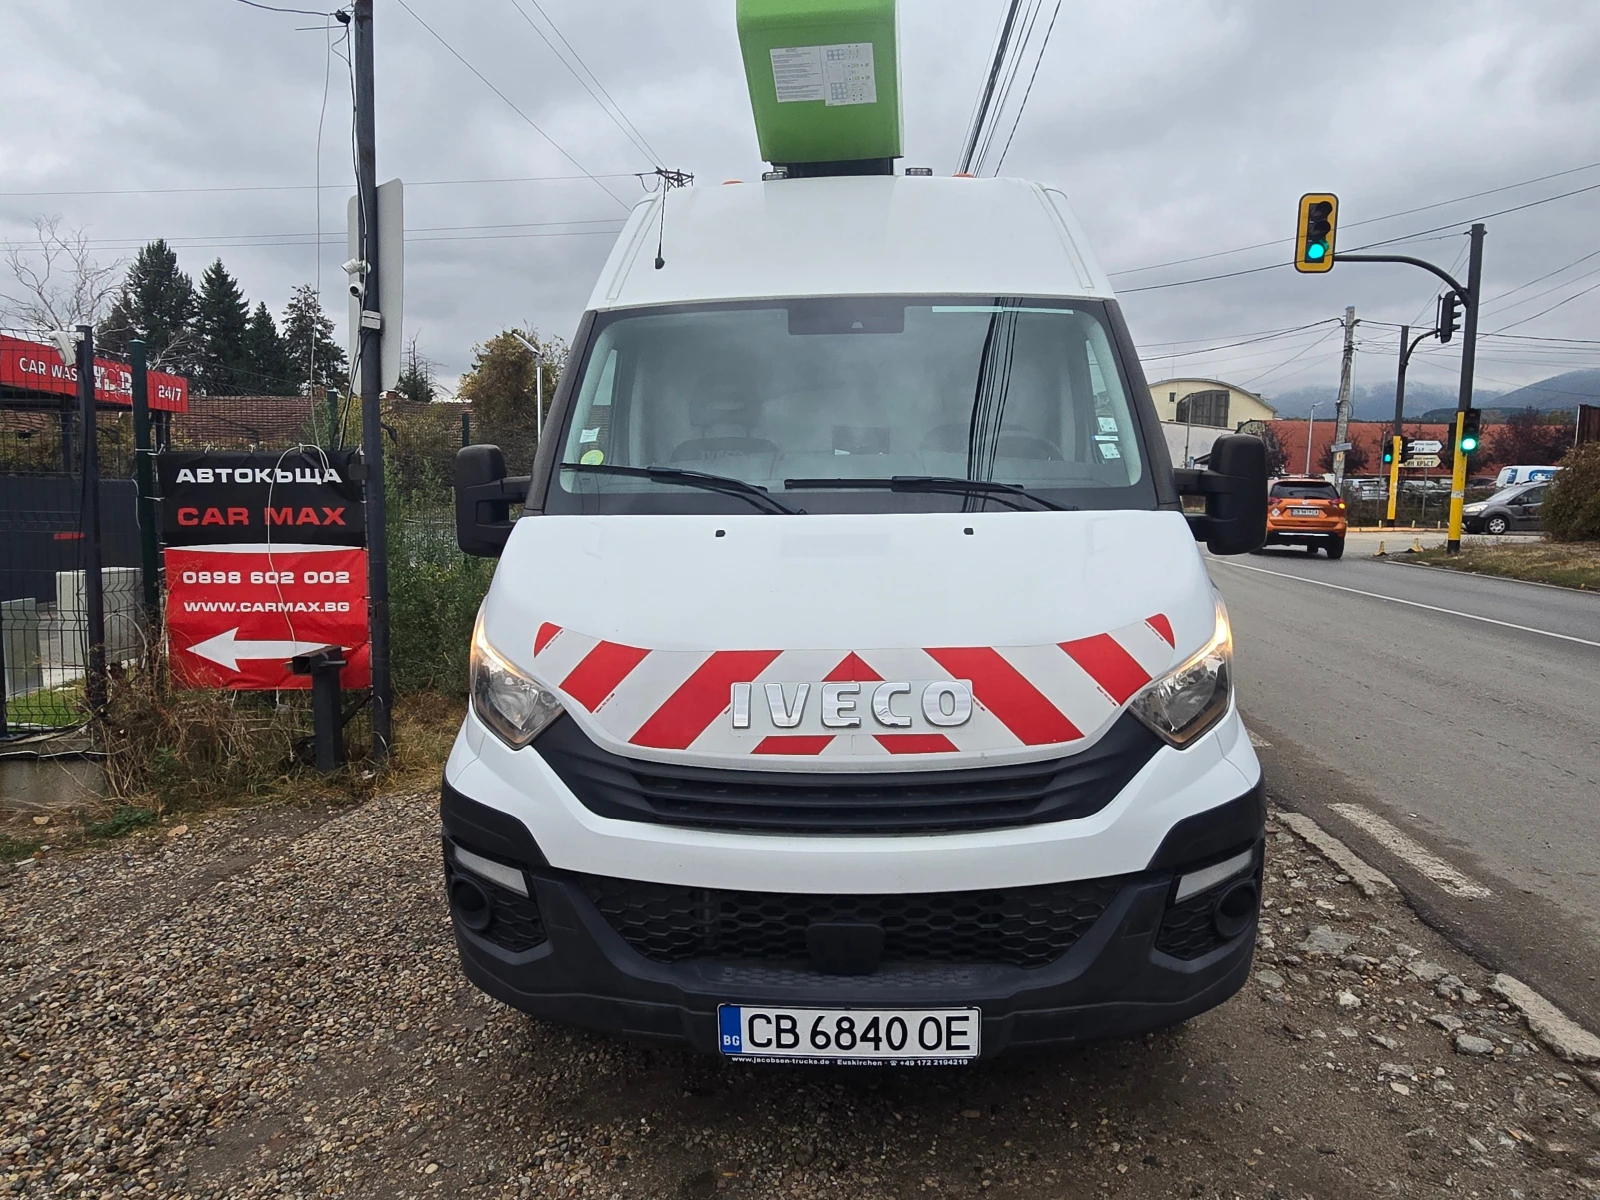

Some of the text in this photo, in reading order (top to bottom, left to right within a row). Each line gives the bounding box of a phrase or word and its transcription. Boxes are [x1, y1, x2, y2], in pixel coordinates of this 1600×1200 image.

[19, 357, 47, 376] CAR
[51, 364, 78, 382] WAS
[158, 384, 182, 402] 24/7
[177, 507, 346, 526] CAR MAX
[182, 571, 350, 584] 0898 602 002
[183, 601, 350, 613] WWW.CARMAX.BG
[732, 681, 973, 729] IVECO
[723, 1035, 740, 1046] BG
[748, 1013, 800, 1049] CB
[810, 1015, 908, 1051] 6840
[731, 1056, 830, 1066] www.jacobsen-trucks.de
[916, 1059, 932, 1067] 172
